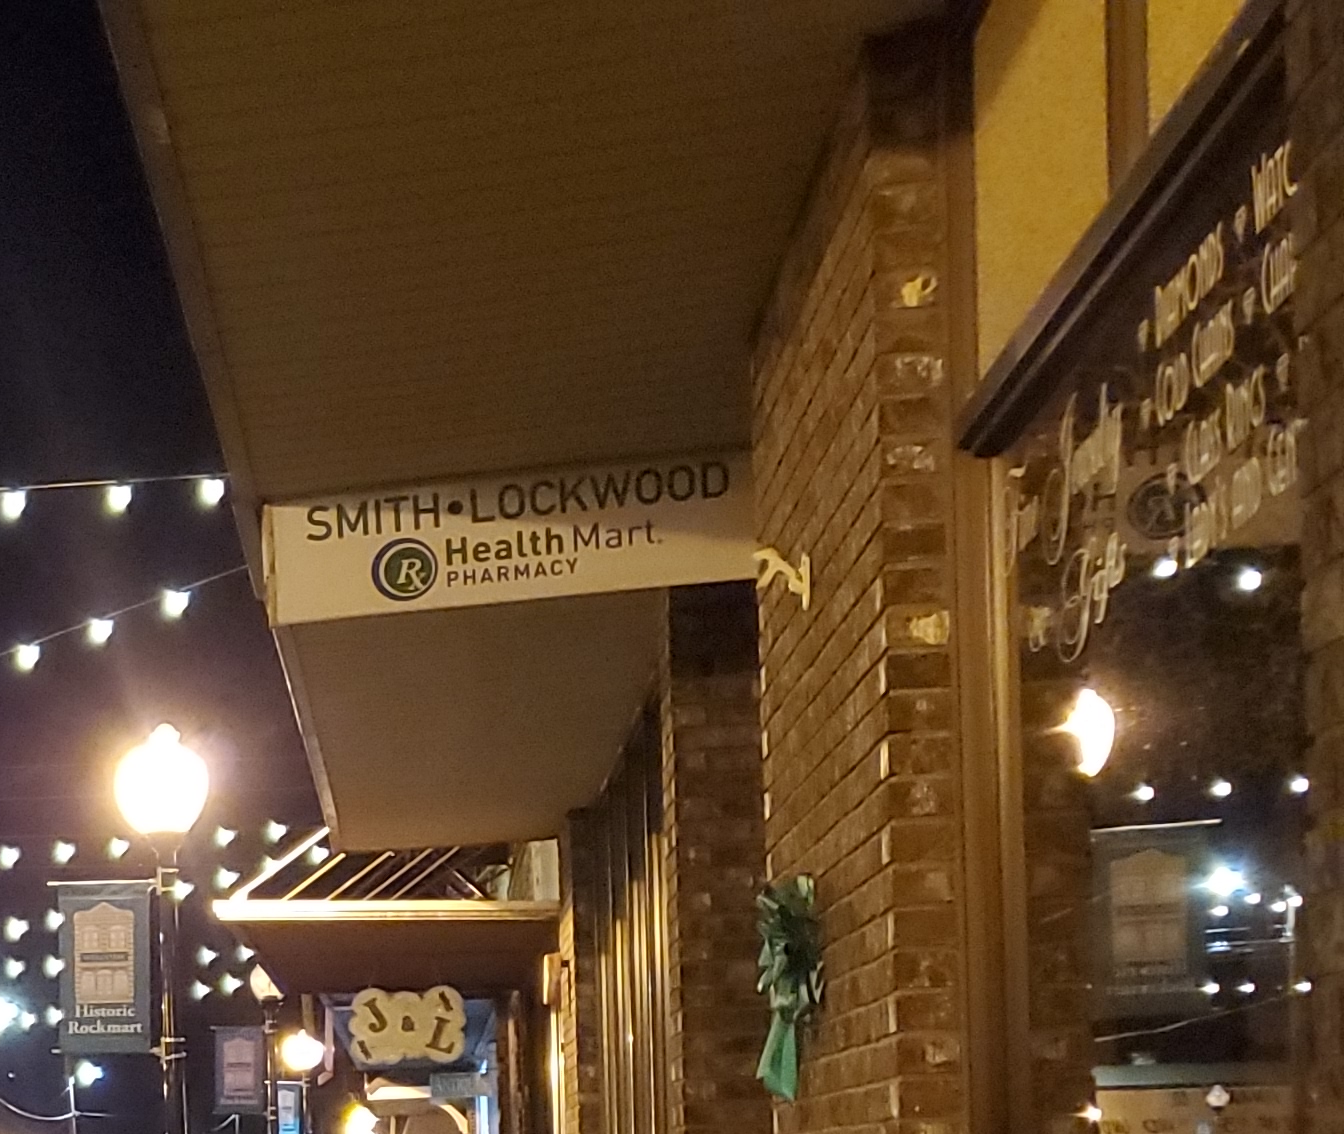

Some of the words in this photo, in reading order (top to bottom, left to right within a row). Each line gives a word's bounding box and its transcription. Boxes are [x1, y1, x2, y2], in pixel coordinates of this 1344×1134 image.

[1251, 140, 1298, 234] WATC
[304, 492, 442, 543] SMITH
[469, 460, 732, 525] LOCKWOOD
[445, 527, 564, 567] Health
[446, 557, 580, 588] PHARMACY
[67, 1019, 143, 1035] Rockmart
[75, 1003, 137, 1018] Historic
[363, 997, 388, 1033] J
[425, 1015, 455, 1055] L
